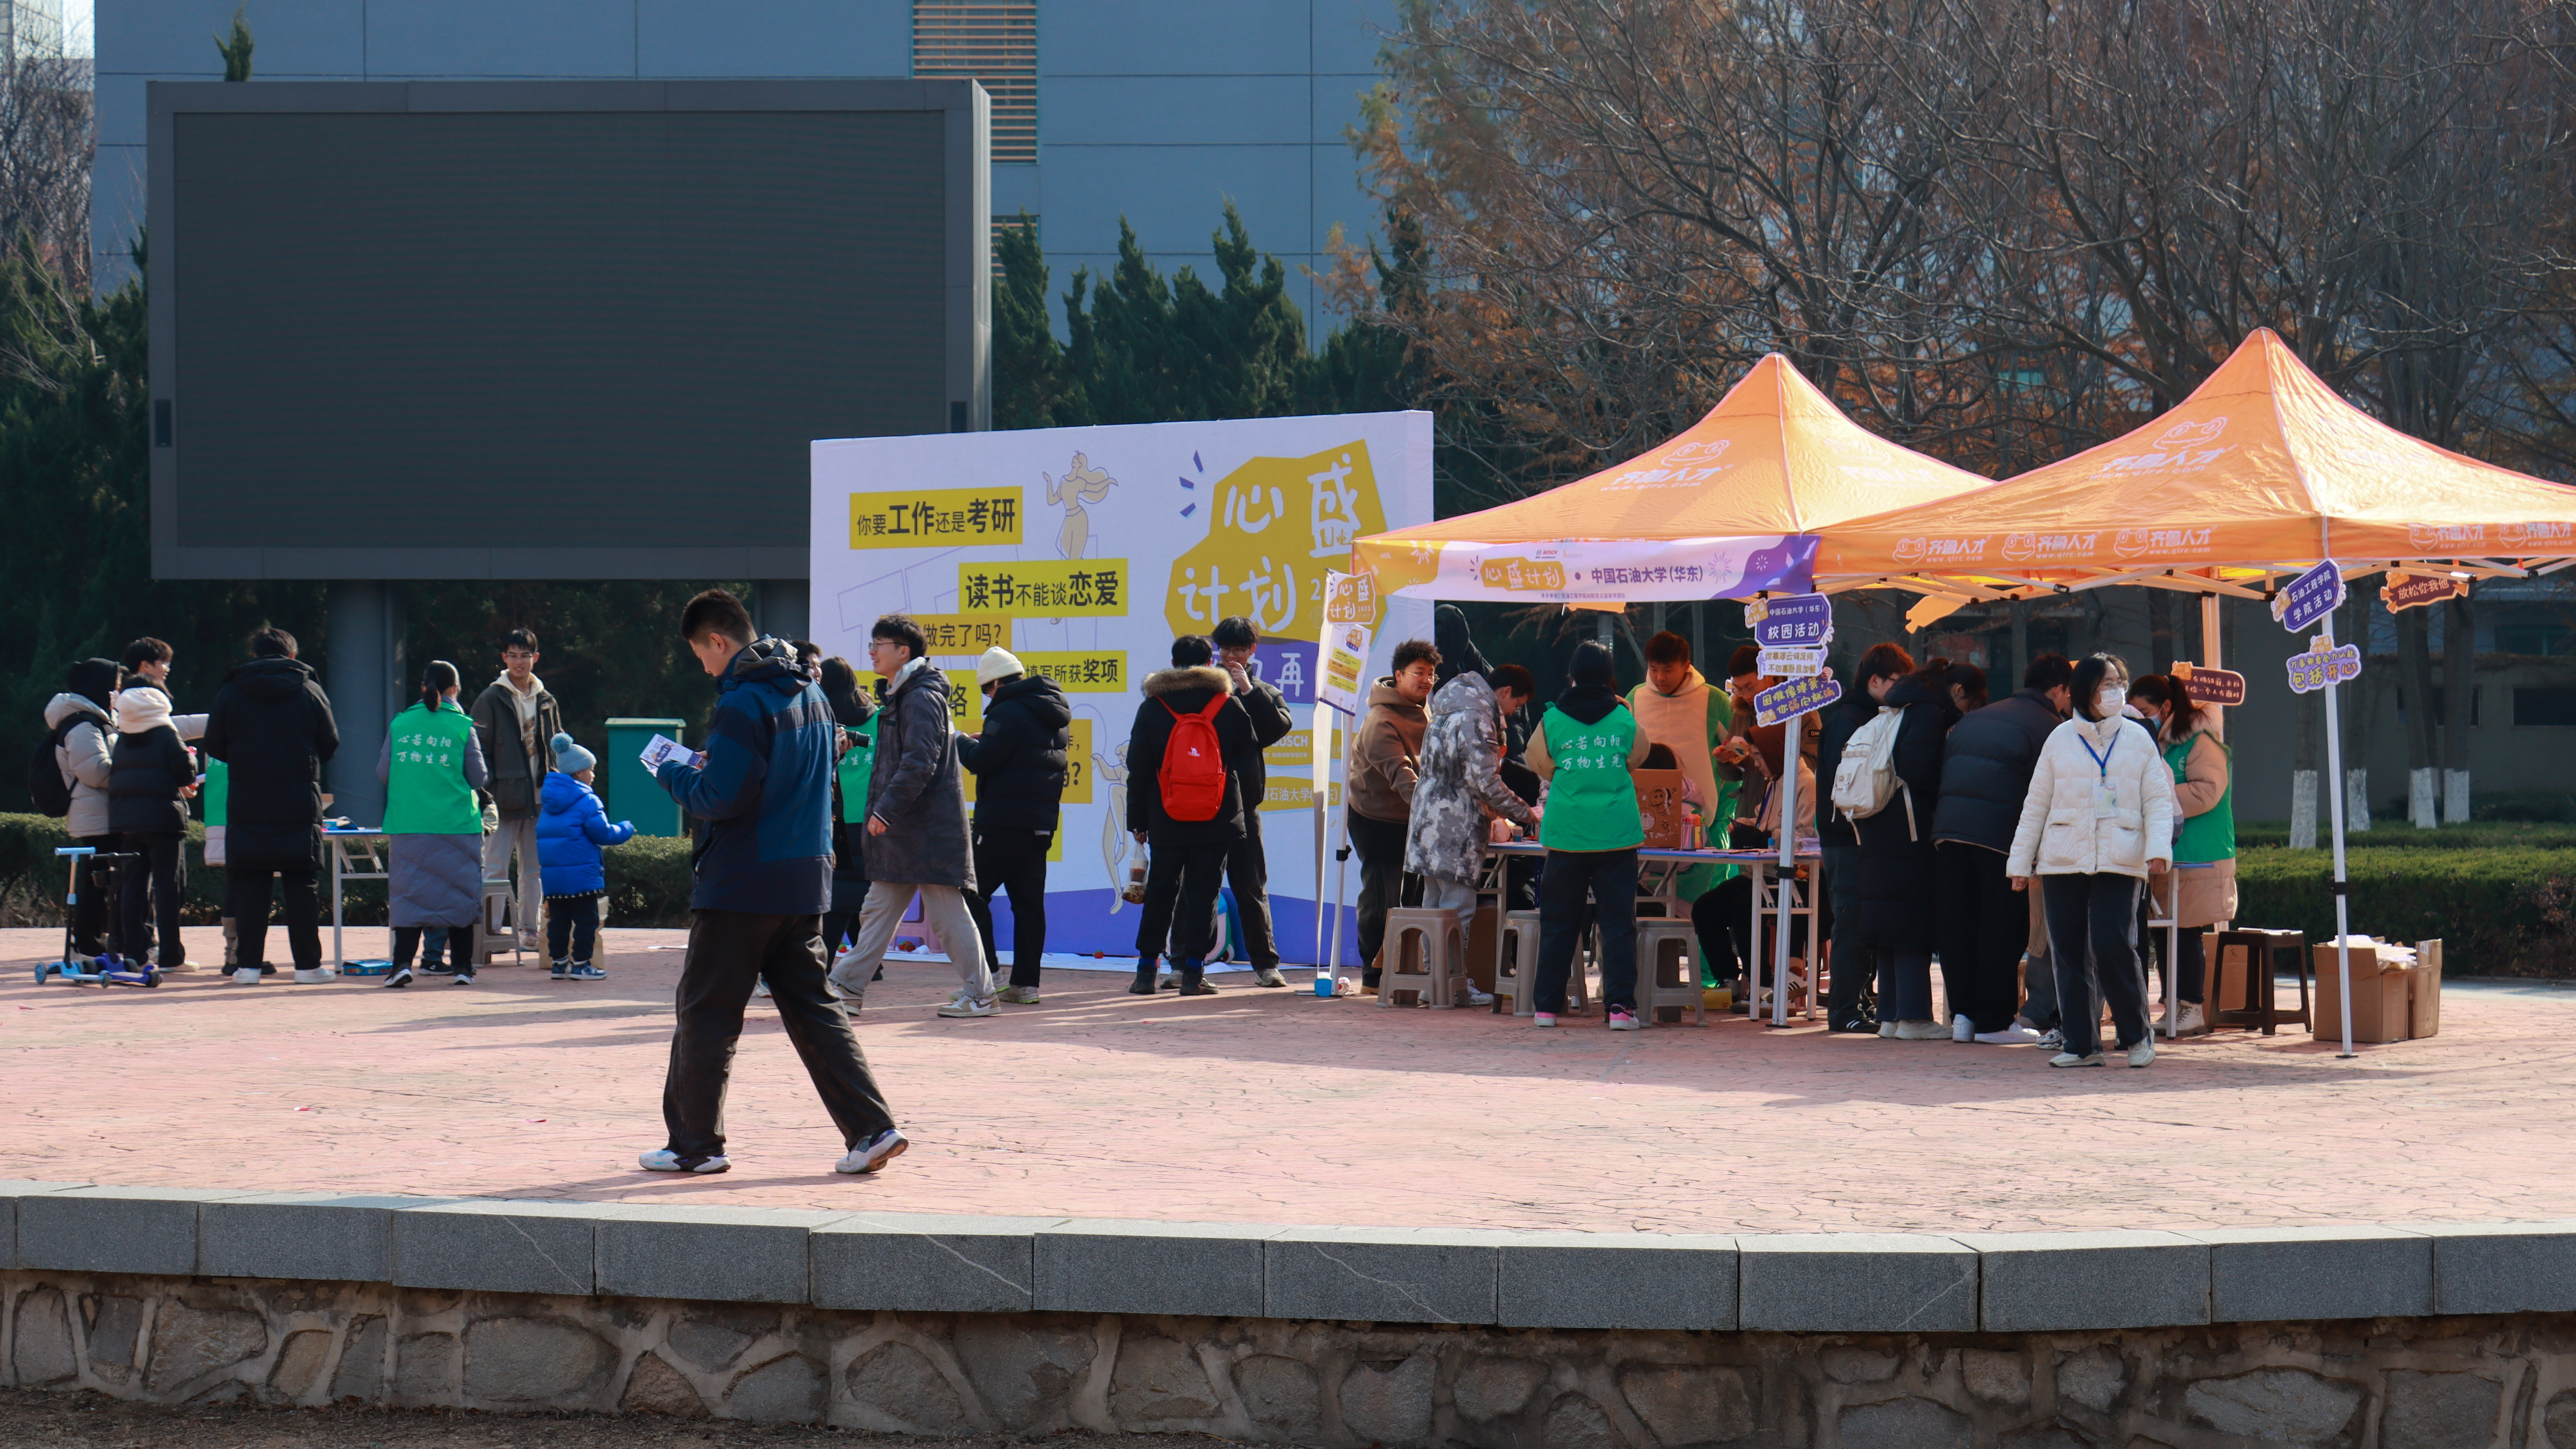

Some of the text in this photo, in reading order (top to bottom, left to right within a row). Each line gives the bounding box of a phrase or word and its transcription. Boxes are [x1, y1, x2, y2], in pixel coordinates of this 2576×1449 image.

[2100, 448, 2226, 472] 齐鲁人才
[1611, 467, 1722, 485] 齐鲁人才
[856, 498, 1016, 536] 你要工作还是考研
[1928, 539, 1987, 555] 齐鲁人才
[2038, 533, 2097, 551] 齐鲁人才
[2150, 529, 2211, 547] 齐鲁人才
[2149, 547, 2210, 555] www.qlrc.com
[1485, 560, 1703, 588] 心盛计划 中国石油大学(华东)
[966, 570, 1118, 609] 读书不能谈恋爱
[1177, 556, 1297, 632] 计划
[2291, 570, 2331, 603] 石油工程学院
[2398, 578, 2449, 600] 放松你我他
[1330, 601, 1355, 619] 计划
[2293, 588, 2332, 621] 学院活动
[923, 623, 1001, 646] 做完了吗?
[1767, 622, 1819, 639] 校园活动
[2291, 649, 2355, 669] 万事都要全力以赴
[2293, 663, 2357, 688] 包括开心
[1776, 686, 1835, 714] 你弱它就强
[398, 733, 451, 747] 心若向阳
[1561, 735, 1621, 750] 心若向阳
[397, 750, 450, 766] 万物生光
[1562, 754, 1622, 771] 万物生光
